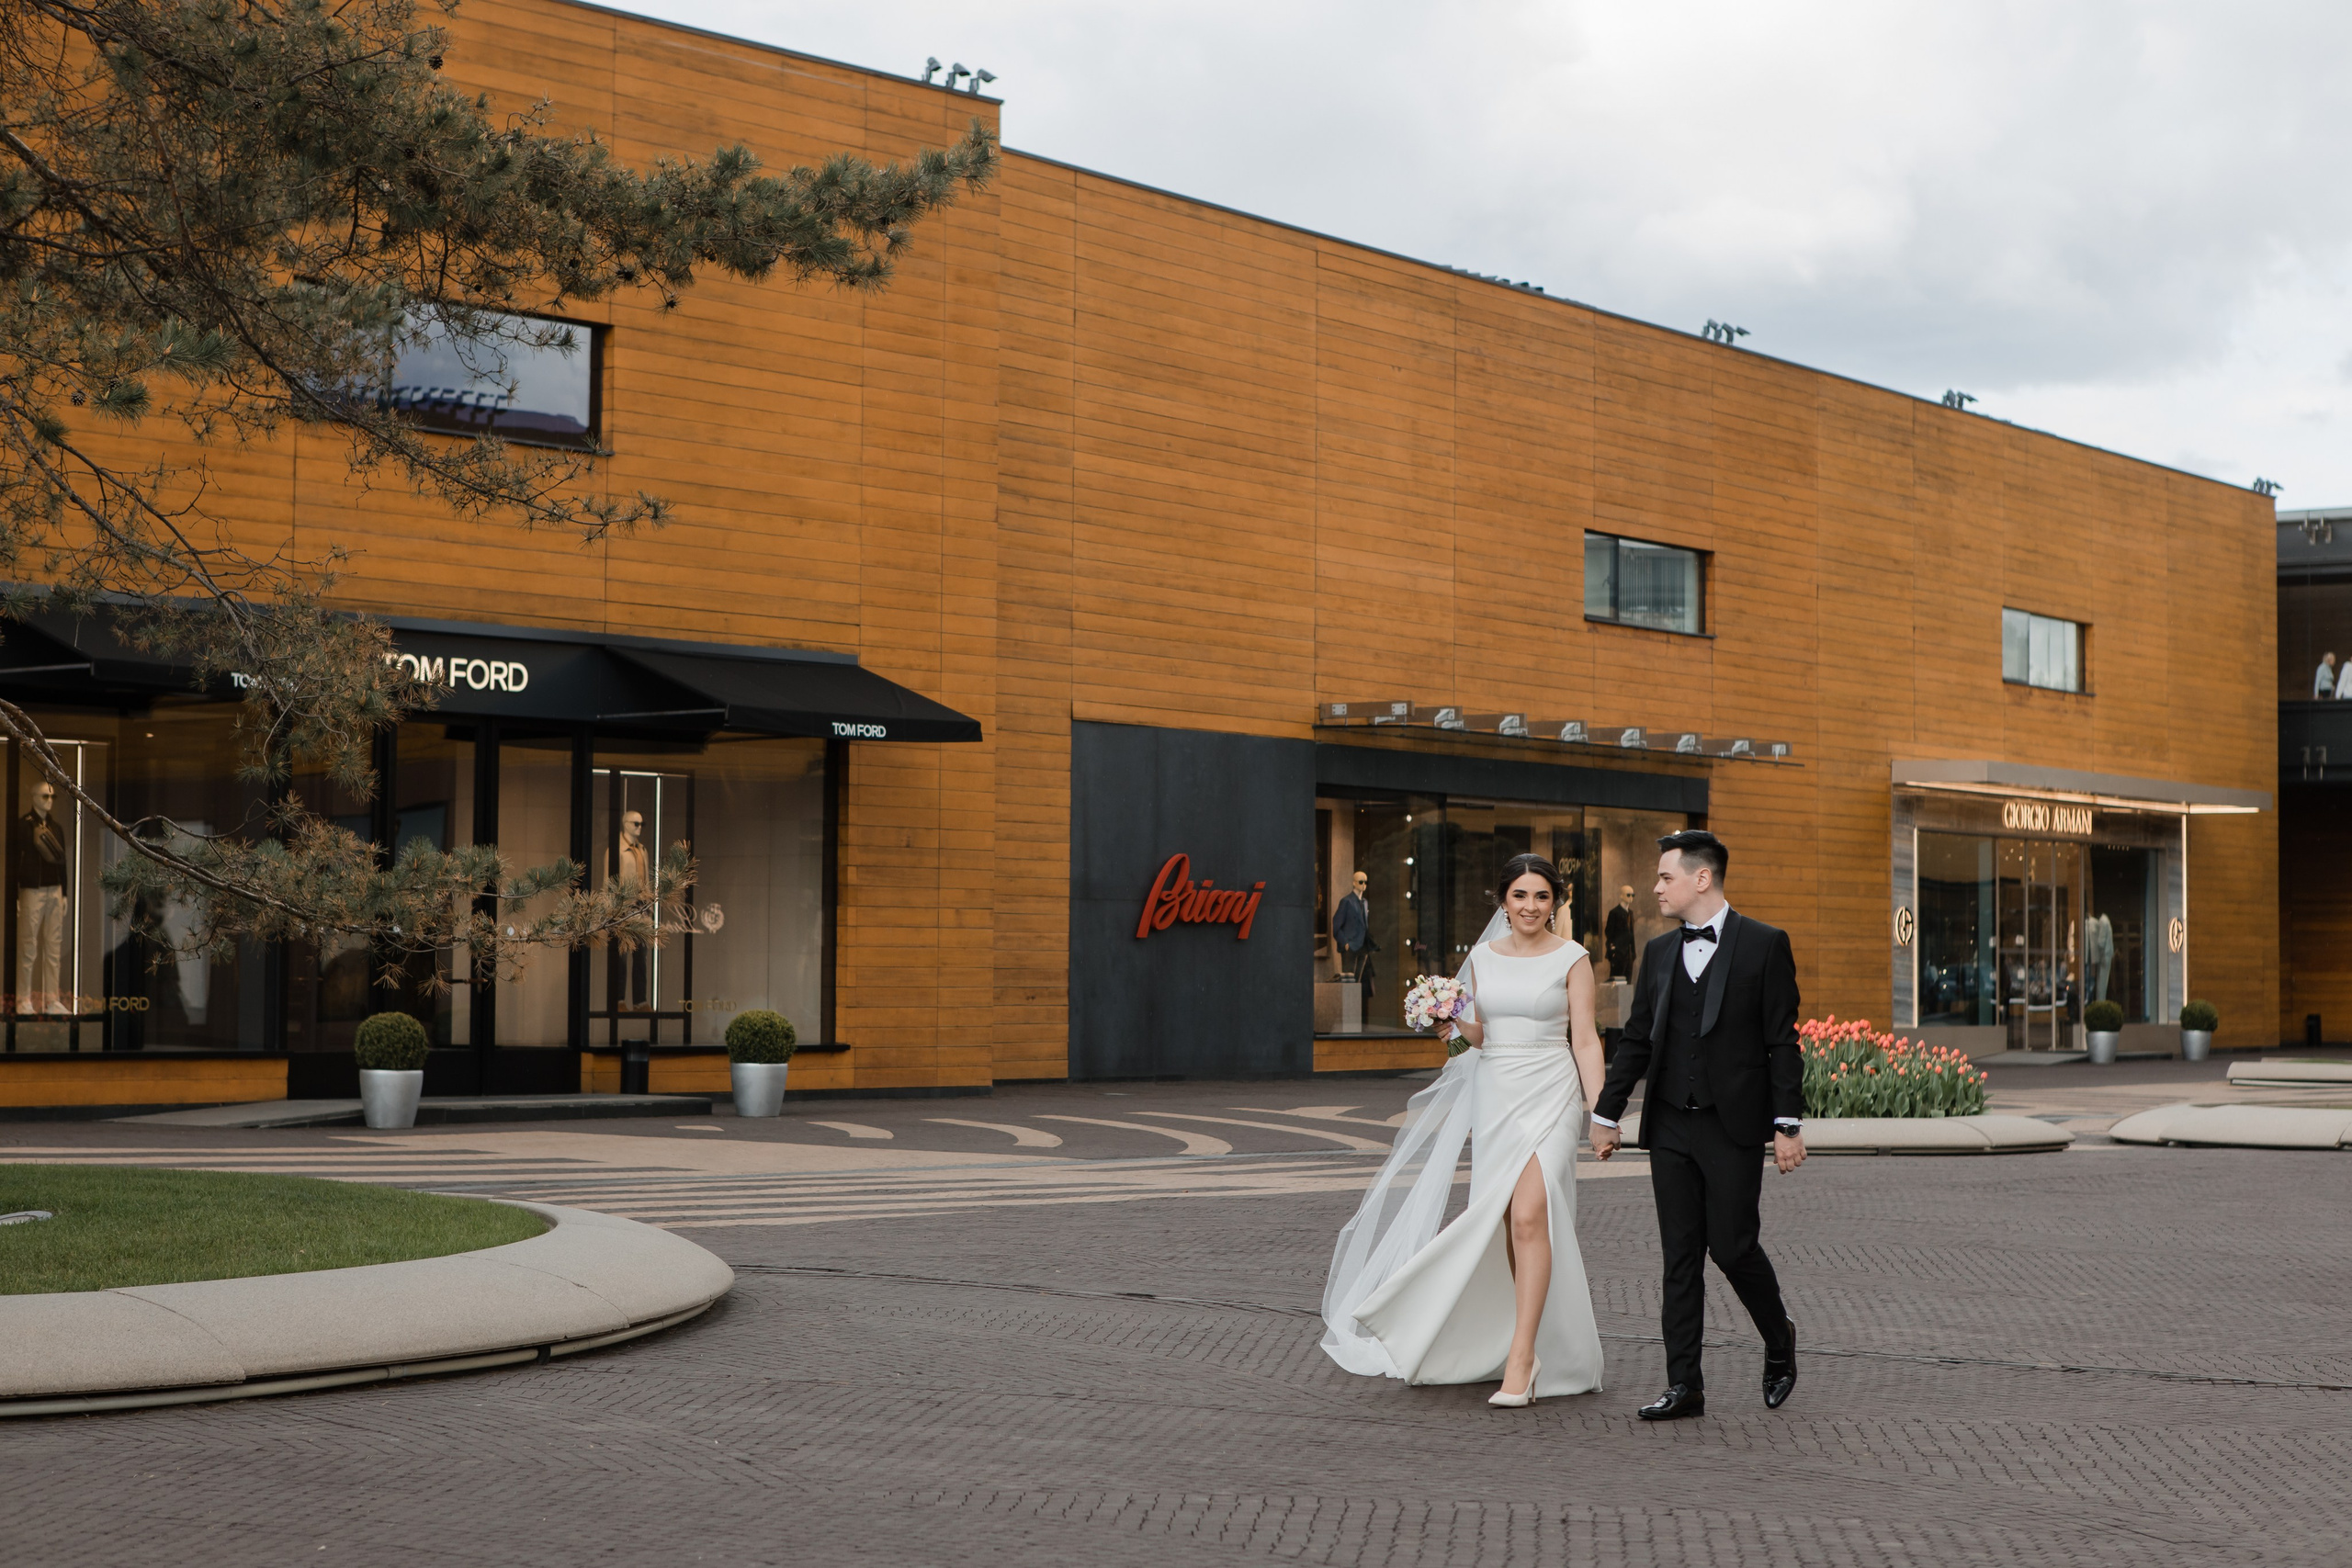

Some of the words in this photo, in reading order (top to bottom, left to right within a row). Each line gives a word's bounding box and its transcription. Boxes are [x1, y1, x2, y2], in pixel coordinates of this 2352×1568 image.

[449, 657, 528, 693] FORD
[831, 722, 856, 737] TOM
[857, 724, 887, 738] FORD
[2003, 802, 2050, 831] GIORGIO
[2052, 806, 2093, 836] ARMANI
[108, 996, 150, 1011] FORD
